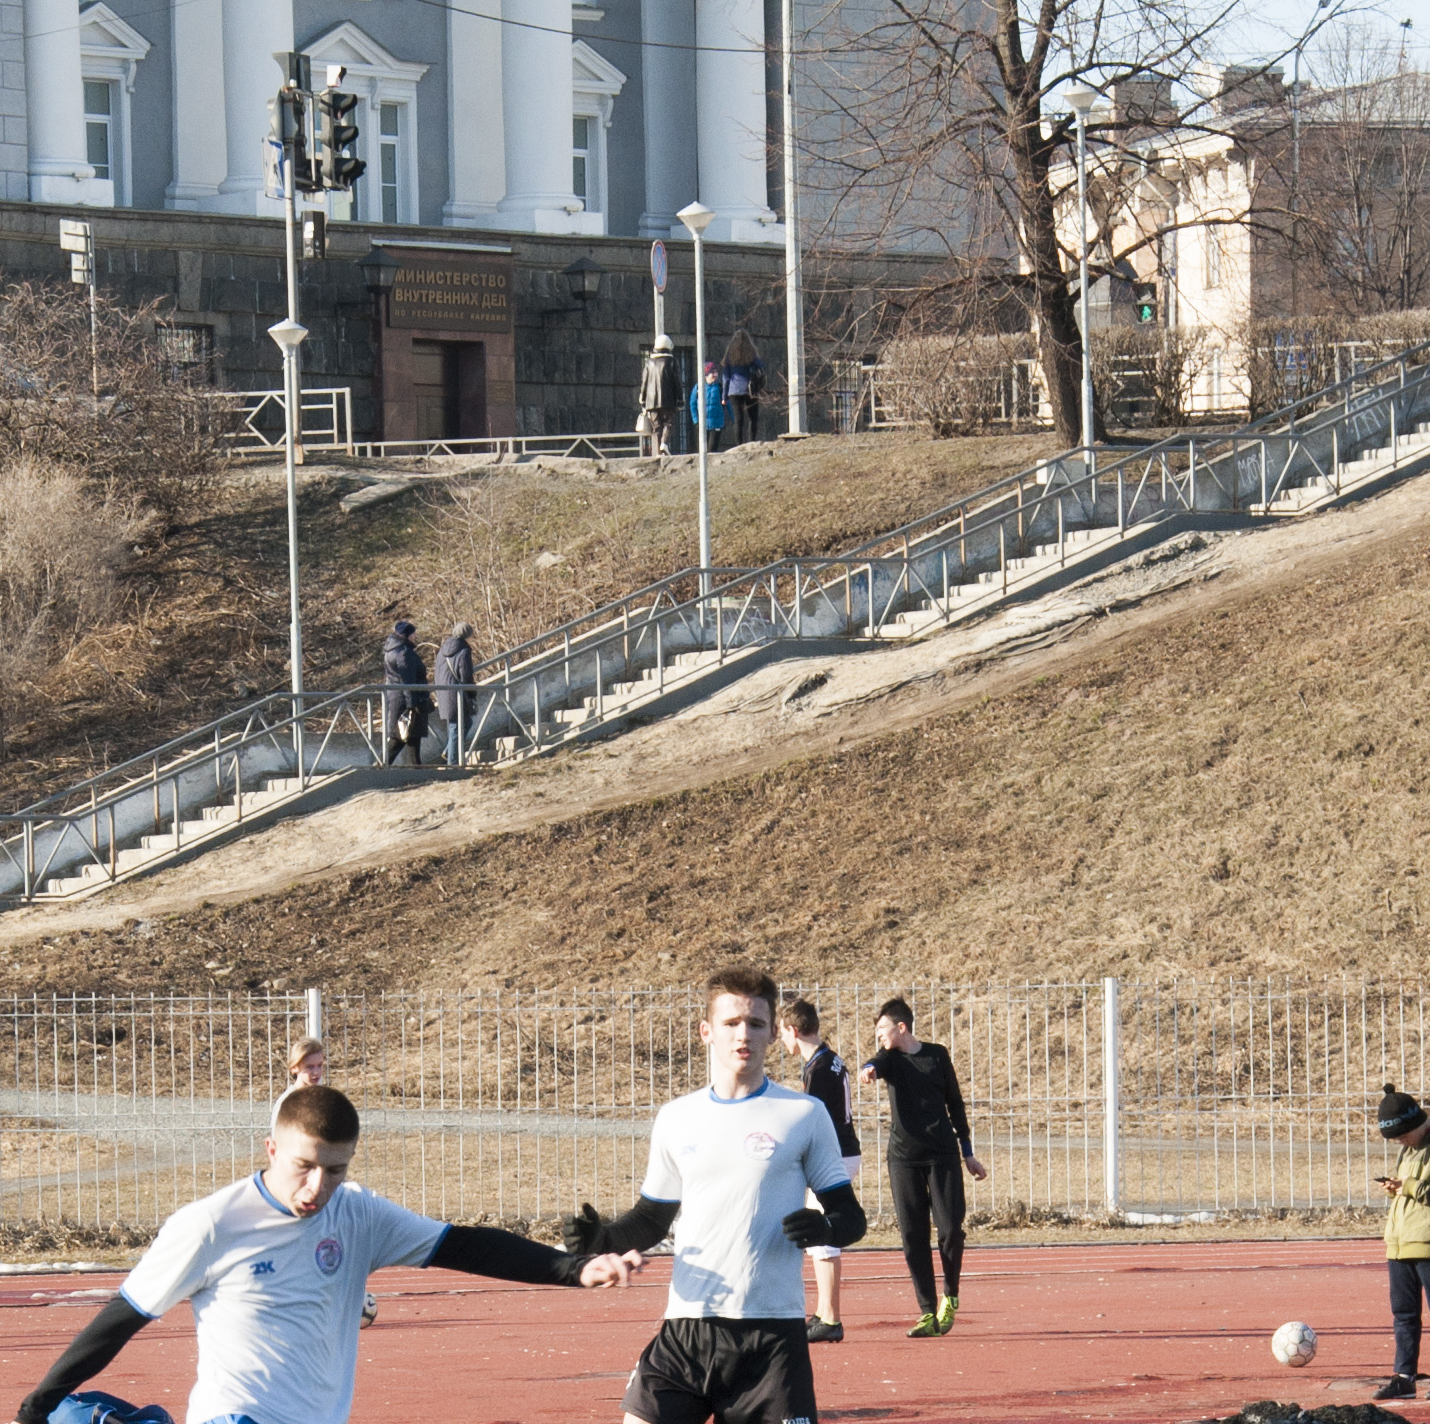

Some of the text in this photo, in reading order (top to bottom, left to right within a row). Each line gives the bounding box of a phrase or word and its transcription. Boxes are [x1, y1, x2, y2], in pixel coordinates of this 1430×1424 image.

[395, 269, 507, 288] МИНИСТЕРСТВО
[395, 288, 507, 309] ВНУТРЕННИХ ДЕЛ
[394, 308, 406, 317] ПО
[411, 310, 464, 319] РЕСПУБЛИКЕ
